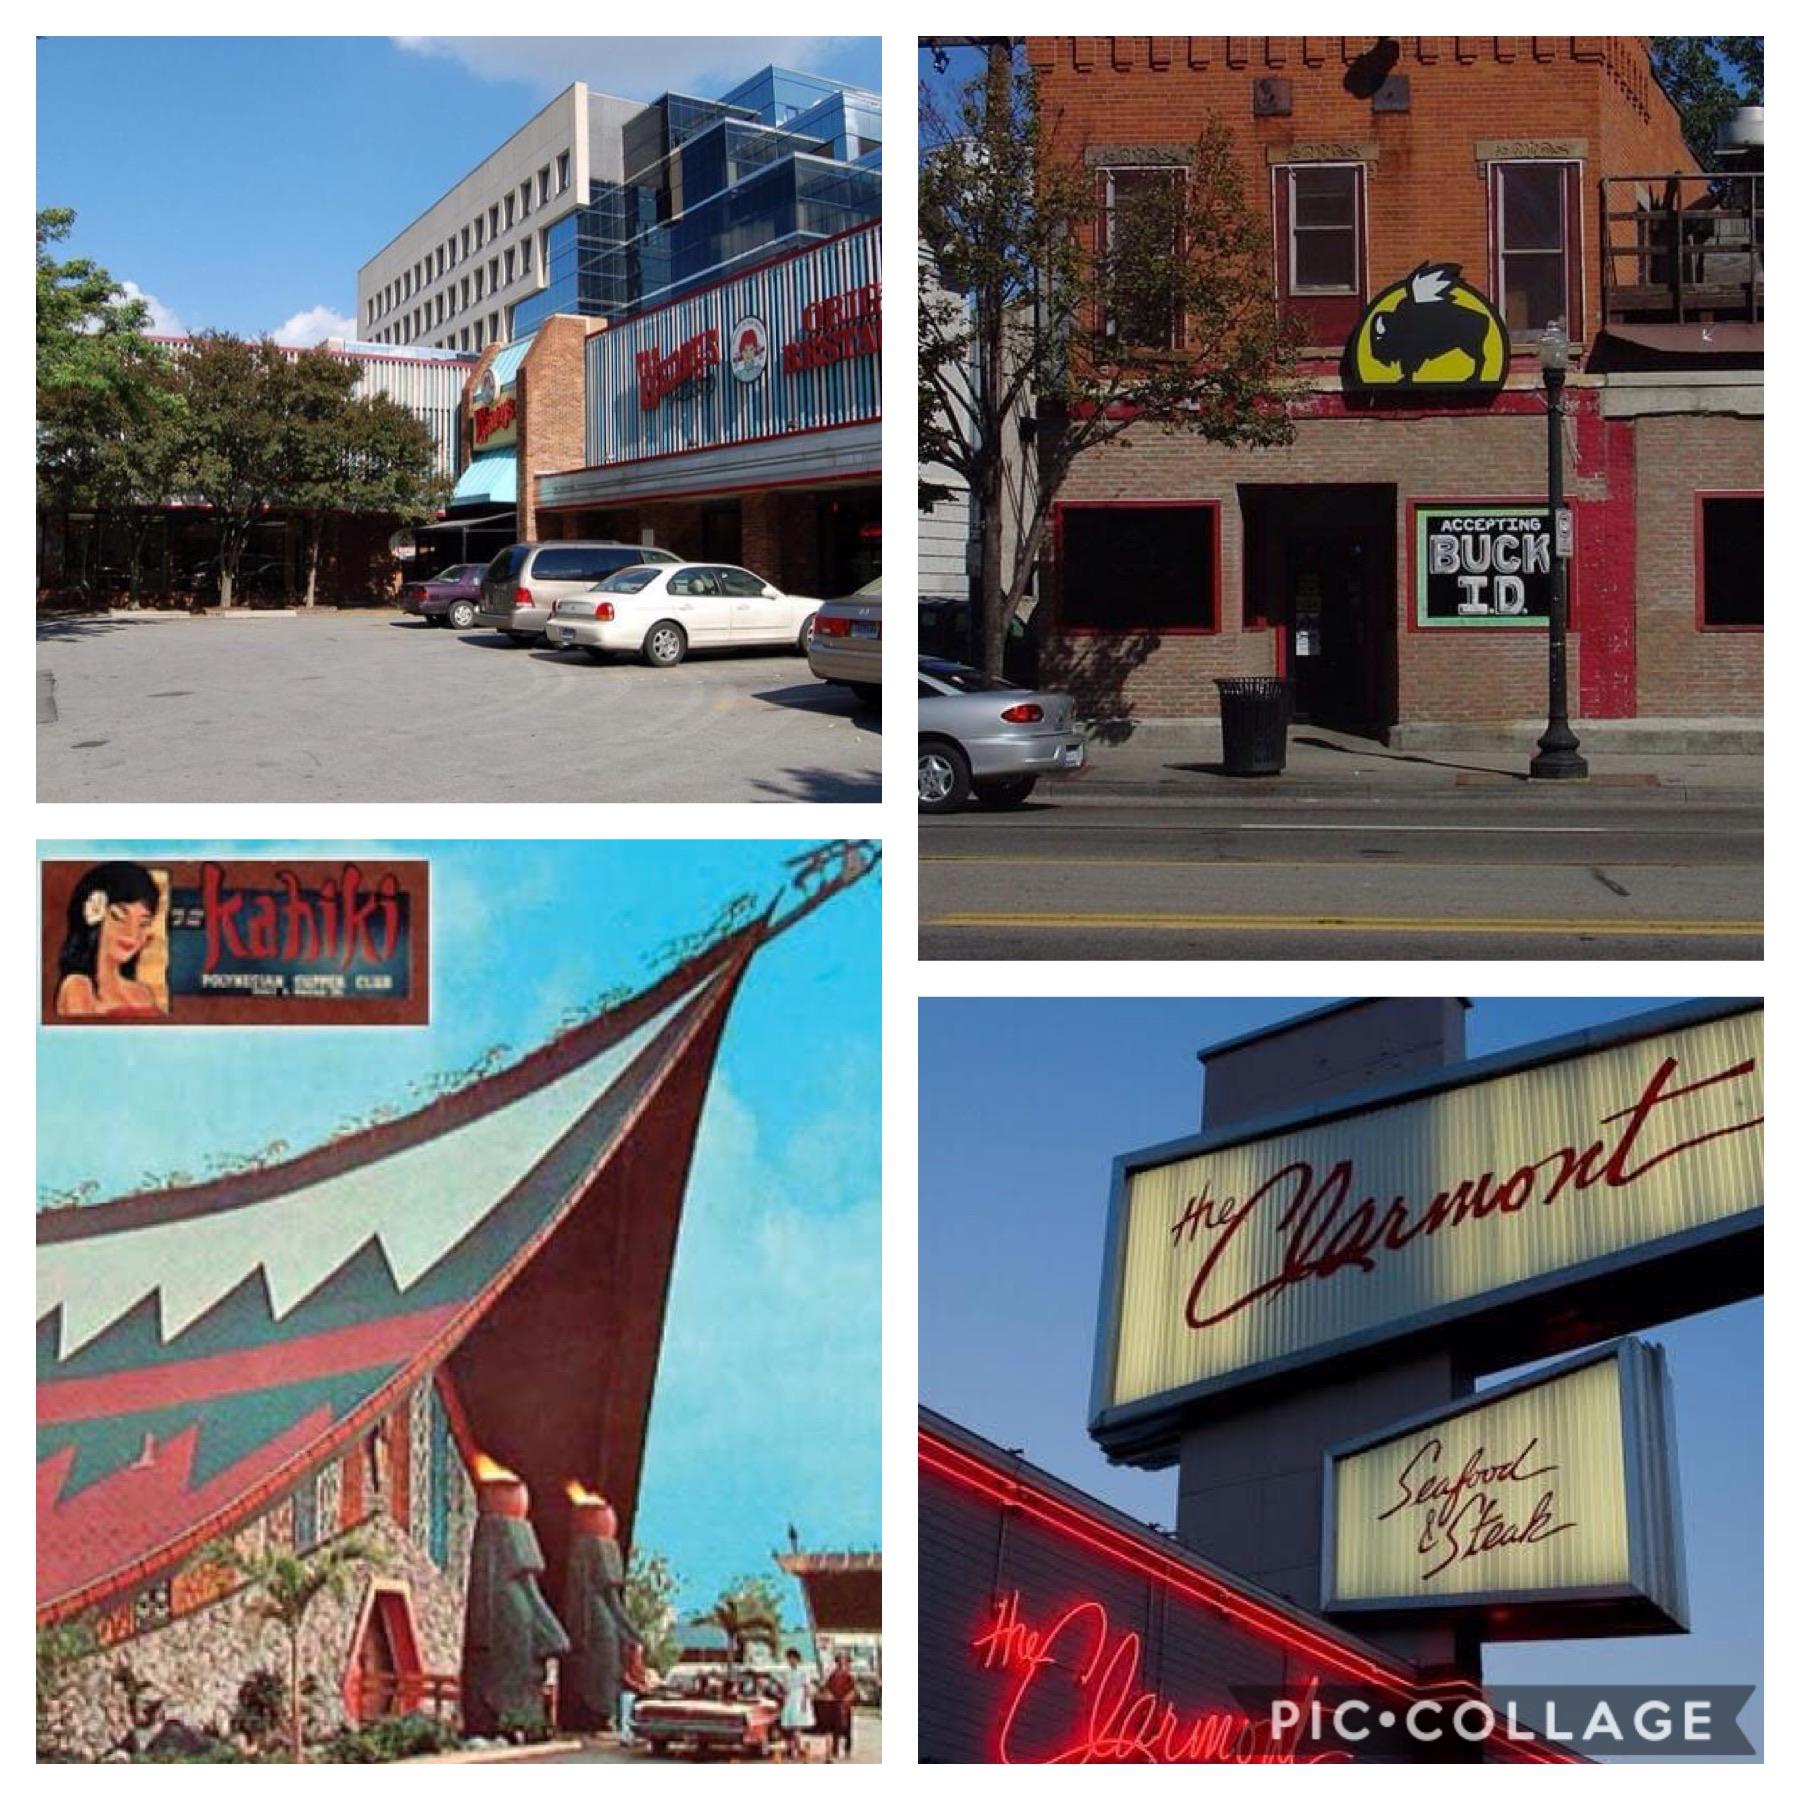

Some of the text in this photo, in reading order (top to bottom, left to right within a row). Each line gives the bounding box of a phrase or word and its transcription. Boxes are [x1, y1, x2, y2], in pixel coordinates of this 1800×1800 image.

[1441, 517, 1541, 532] ACCEPTING
[1429, 534, 1551, 574] BUCK
[1457, 575, 1528, 615] I.D.
[356, 974, 393, 988] CLUB
[1186, 1057, 1764, 1329] Clarmont
[1378, 1438, 1559, 1526] Seafood
[1418, 1491, 1577, 1580] & Steak
